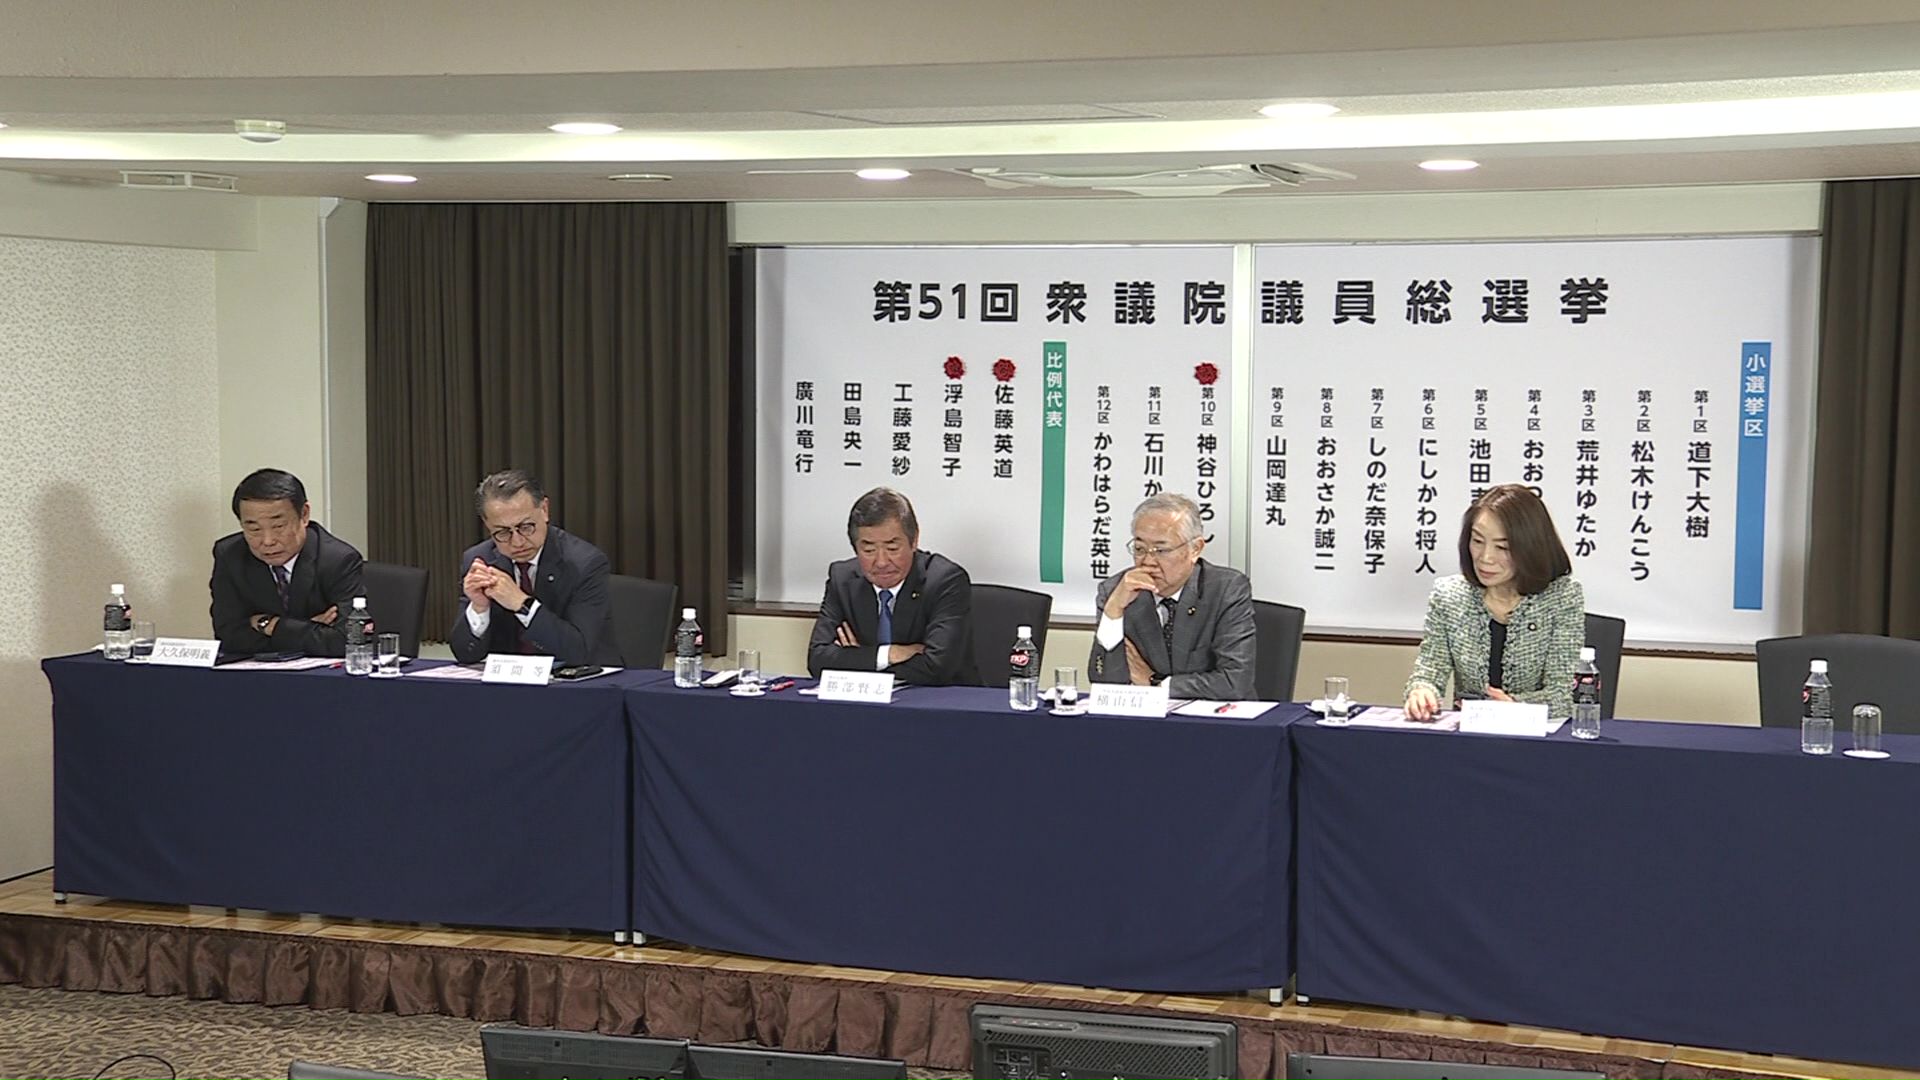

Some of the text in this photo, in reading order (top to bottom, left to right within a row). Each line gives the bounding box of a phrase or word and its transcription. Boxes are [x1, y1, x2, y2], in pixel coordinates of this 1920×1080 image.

[795, 380, 815, 474] 廣川竜行
[843, 382, 862, 467] 田島央一
[891, 383, 913, 476] 工藤愛紗
[942, 383, 963, 477] 浮島智子
[993, 380, 1015, 479] 佐藤英道
[1046, 351, 1063, 427] 比例代表
[1148, 386, 1161, 425] 第11区
[1201, 387, 1216, 426] 第10区
[1474, 389, 1488, 431] 第5区
[1527, 389, 1541, 431] 第4区
[1744, 354, 1766, 436] 小選挙区
[1090, 385, 1113, 581] 第12区 かわはらだ英世
[1265, 387, 1287, 526] 第9区 山岡達丸
[1314, 387, 1337, 571] 第8区 おおさか誠二
[1364, 388, 1387, 574] 第7区 しのだ奈保子
[1415, 388, 1438, 575] 第6区 にしかわ将人
[1575, 389, 1600, 557] 第3区 荒井ゆたか
[1630, 390, 1655, 581] 第2区 松木けんこう
[1685, 390, 1712, 538] 第1区 道下大樹
